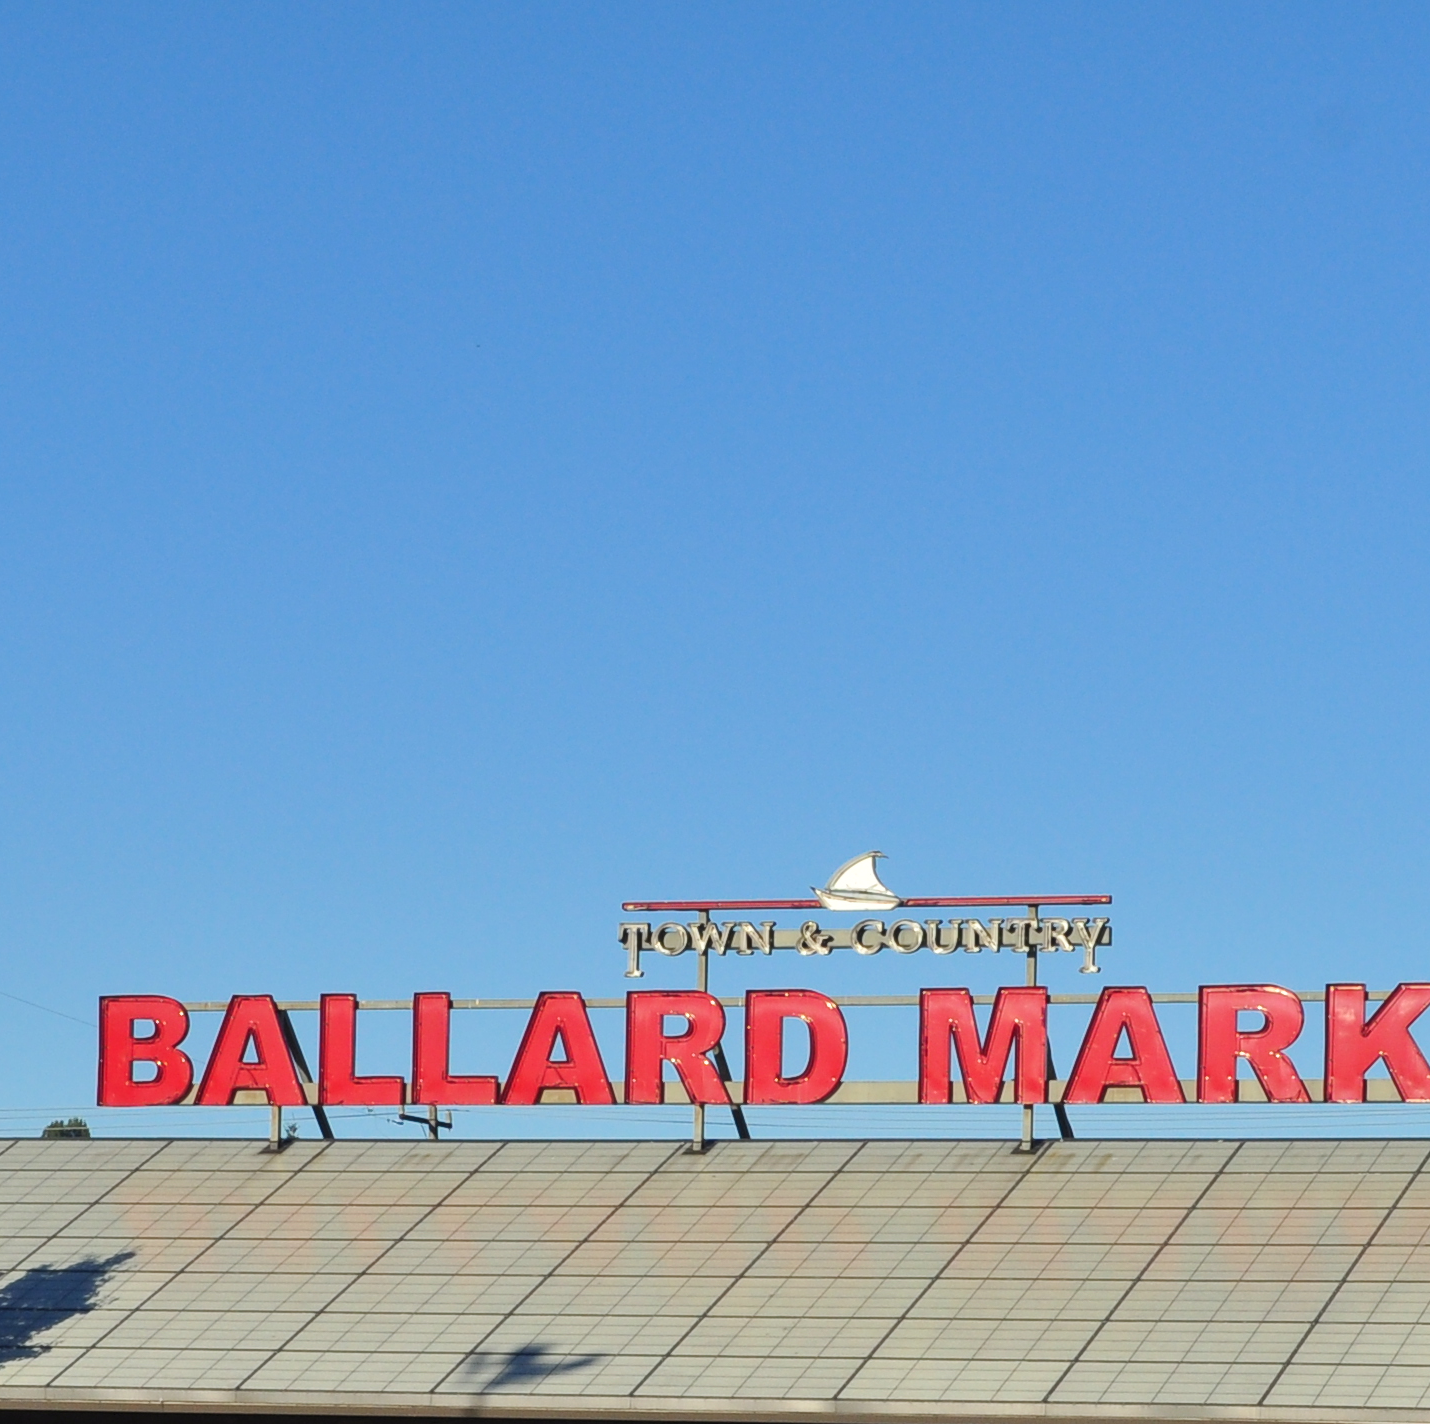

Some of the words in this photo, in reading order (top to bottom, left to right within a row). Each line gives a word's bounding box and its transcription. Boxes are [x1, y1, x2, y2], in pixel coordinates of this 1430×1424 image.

[619, 919, 776, 978] TOWN
[795, 920, 831, 957] &
[850, 917, 1109, 974] COUNTRY
[97, 988, 850, 1107] BALLARD
